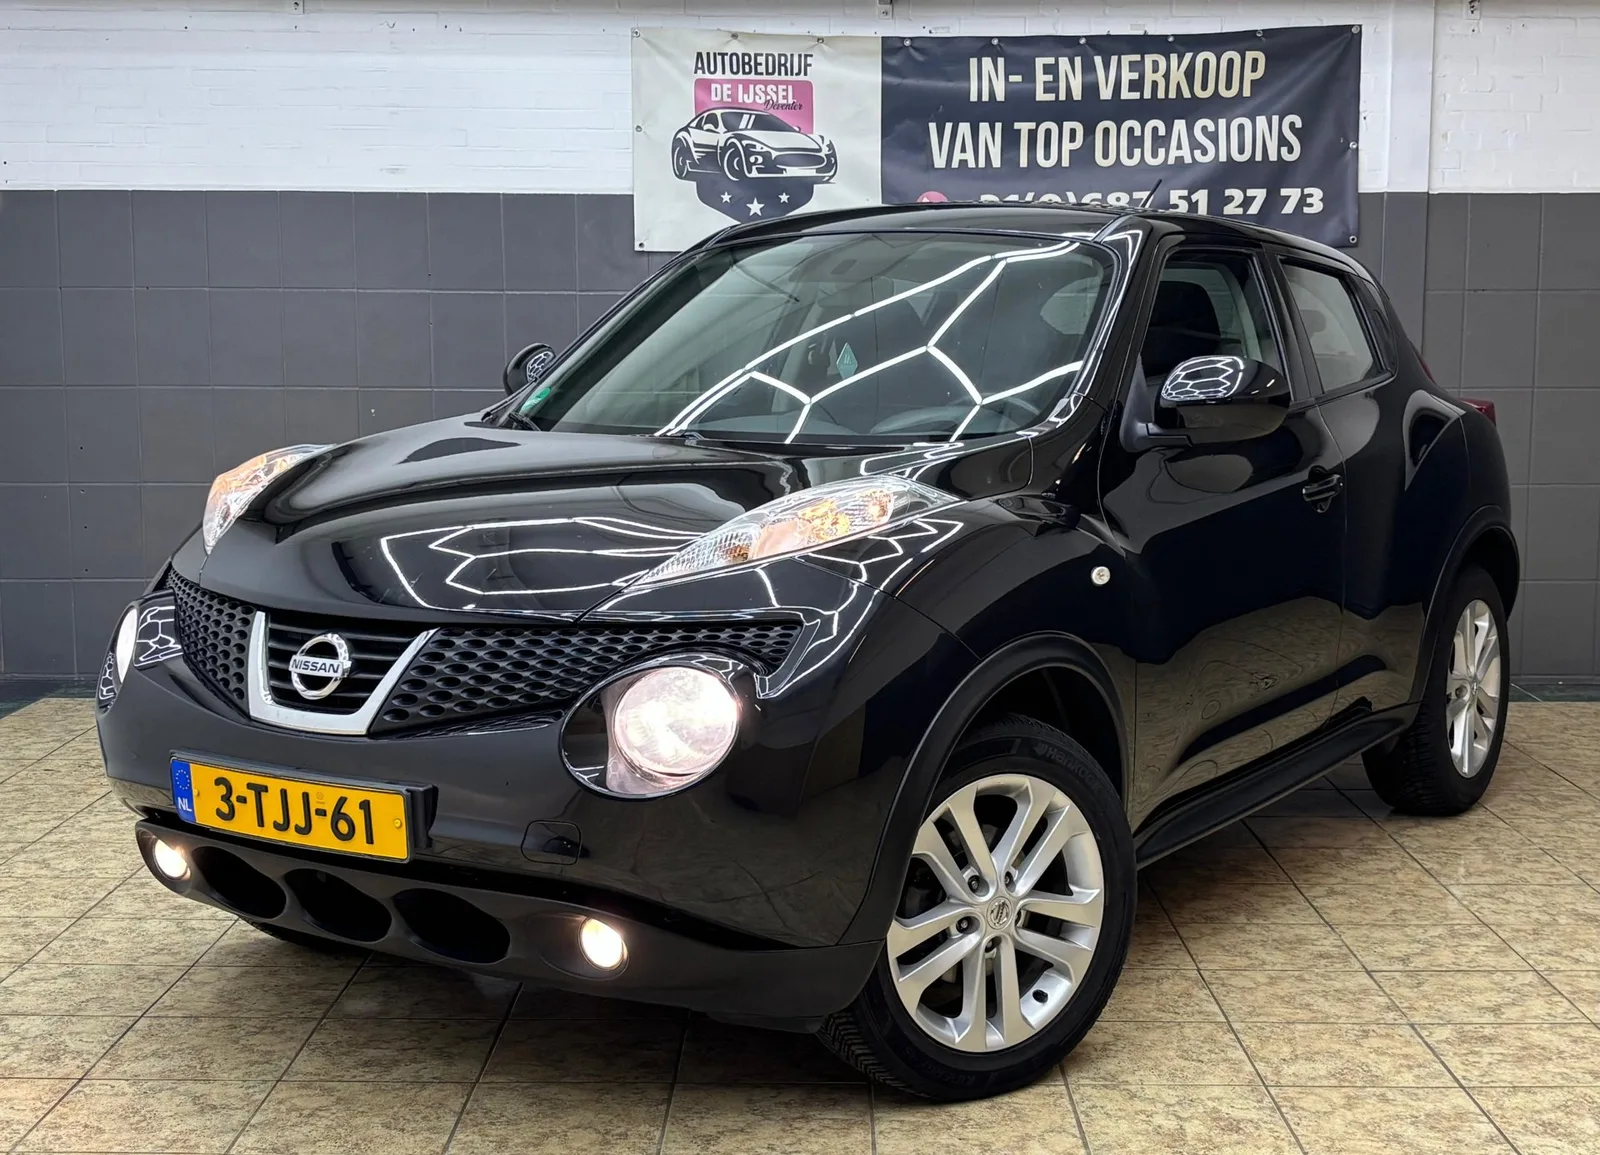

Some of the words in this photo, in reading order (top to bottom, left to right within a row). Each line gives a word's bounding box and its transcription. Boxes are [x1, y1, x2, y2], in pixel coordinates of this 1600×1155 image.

[693, 51, 814, 76] AUTOBEDRIJF
[969, 56, 1022, 102] IN-
[1035, 56, 1082, 101] EN
[1093, 50, 1266, 99] VERKOOP
[711, 83, 732, 102] DE
[738, 83, 797, 103] IJSSEL
[764, 99, 803, 111] Deventer
[929, 122, 1002, 168] VAN
[1014, 121, 1083, 168] TOP
[1094, 114, 1302, 167] OCCASIONS
[1169, 189, 1208, 215] 51
[1223, 188, 1267, 215] 27
[1280, 187, 1324, 214] 73
[292, 658, 340, 674] NISSAN
[177, 797, 192, 812] NL
[214, 777, 374, 845] 3-TJJ-61
